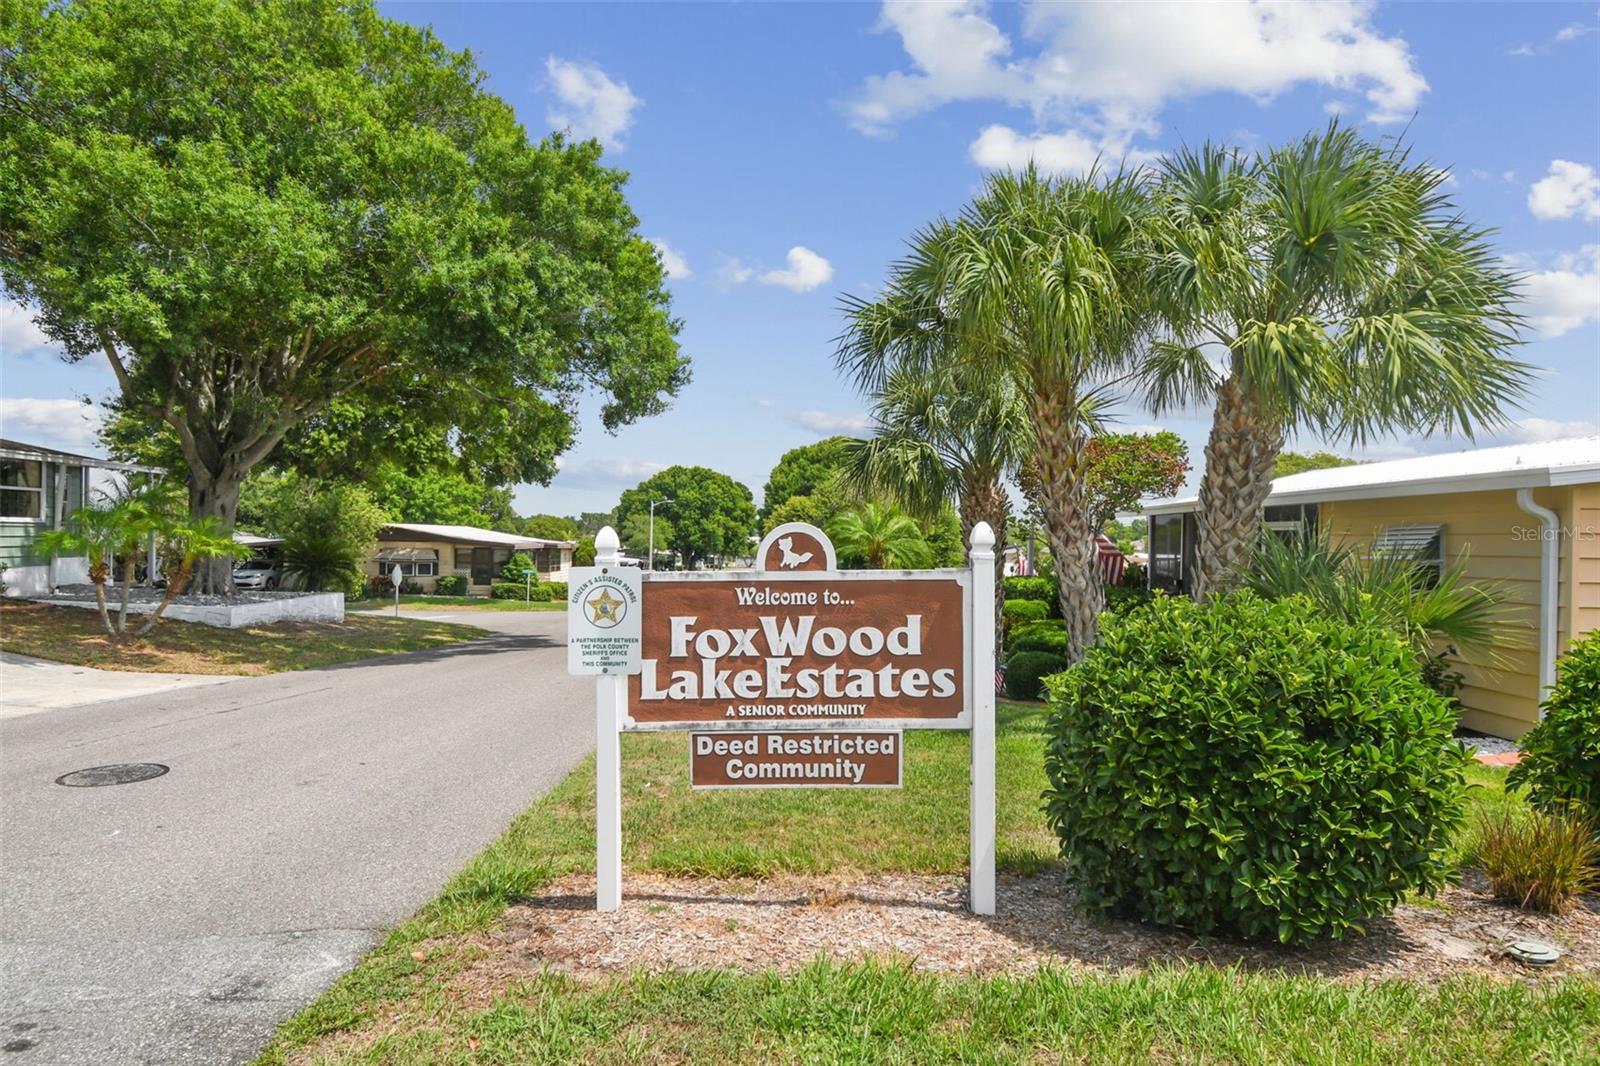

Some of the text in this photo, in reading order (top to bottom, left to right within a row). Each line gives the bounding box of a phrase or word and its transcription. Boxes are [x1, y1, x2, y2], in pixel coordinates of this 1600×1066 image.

[594, 576, 623, 585] ASSISTED
[621, 583, 637, 603] PATROL
[735, 587, 855, 605] Welcome to...
[669, 614, 922, 659] FoxWood
[640, 658, 956, 700] LakeEstates
[725, 704, 867, 716] A SENIOR COMMUNITY
[696, 735, 894, 755] Deed Restricted
[726, 758, 865, 783] Community
